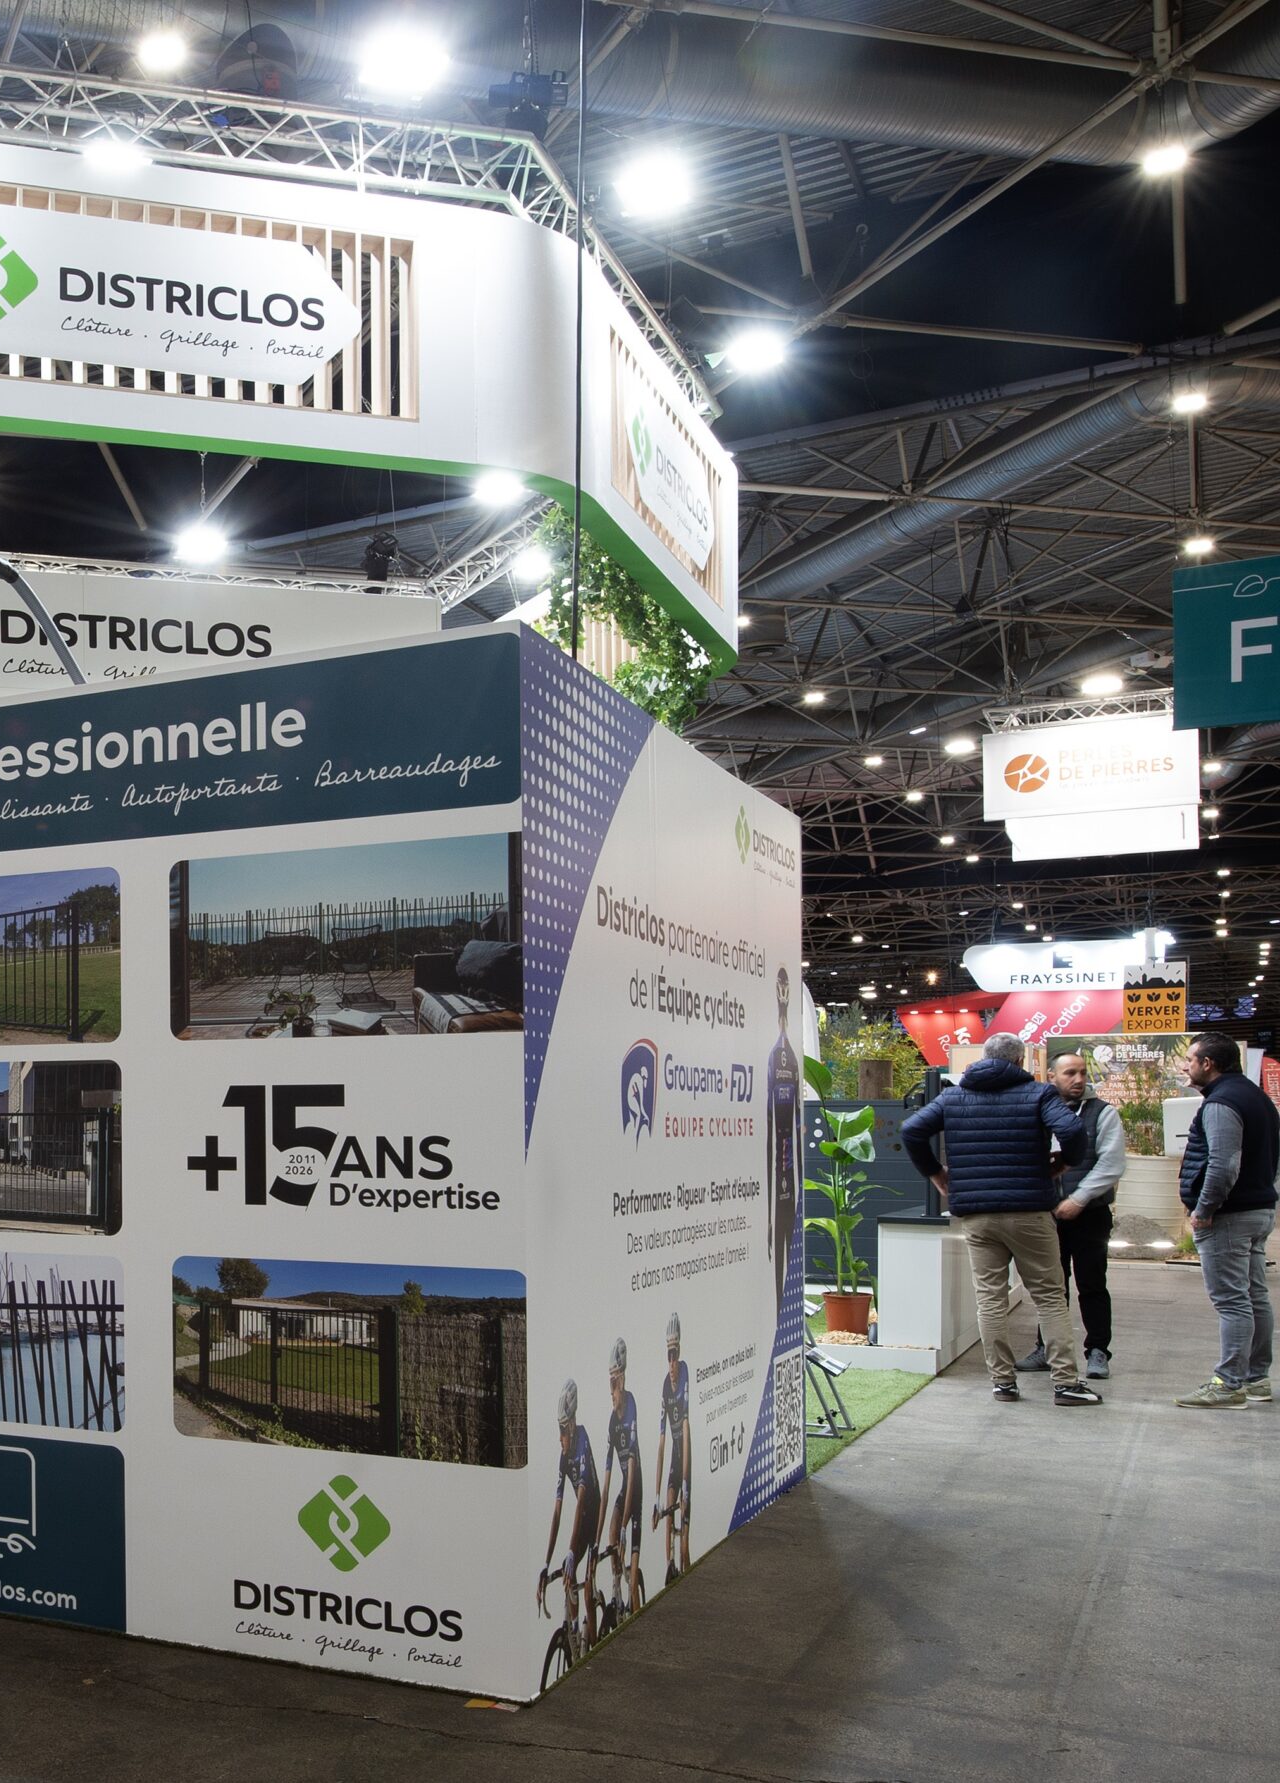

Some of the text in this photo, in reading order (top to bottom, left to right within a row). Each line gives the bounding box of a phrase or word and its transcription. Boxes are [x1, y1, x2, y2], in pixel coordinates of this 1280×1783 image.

[59, 266, 325, 331] DISTRICLOS
[61, 316, 325, 359] Clôture Grillage Portail
[656, 444, 708, 531] DISTRICLOS
[3, 658, 157, 680] Clôtur Grill
[1231, 616, 1278, 683] F
[121, 771, 282, 816] Autoportants
[315, 752, 501, 788] Barreaudages
[1059, 757, 1174, 781] DE PIERRES
[753, 830, 796, 872] DISTRICLOS
[597, 885, 766, 978] Districlos partenaire officiel
[1010, 971, 1116, 985] FRAYSSINET
[629, 969, 647, 1009] de
[704, 990, 745, 1030] cycliste
[1127, 1005, 1180, 1016] VERVER
[1127, 1018, 1180, 1030] EXPORT
[1116, 1044, 1148, 1052] PERLES
[1116, 1051, 1164, 1059] DE PIERRES
[664, 1053, 753, 1103] Groupama FDJ
[665, 1112, 753, 1138] ÉQUIPE CYCLISTE
[285, 1165, 313, 1176] 2026
[289, 1154, 316, 1164] 2011
[330, 1135, 453, 1180] ANS
[329, 1183, 500, 1212] D'expertise
[613, 1176, 760, 1217] Performance Rigueur Esprit d'équipe
[626, 1232, 643, 1255] Des
[644, 1227, 671, 1250] valeurs
[670, 1220, 706, 1248] partagées
[707, 1221, 717, 1237] sur
[718, 1216, 726, 1234] les
[631, 1272, 640, 1292] et
[641, 1266, 661, 1288] dans
[661, 1264, 674, 1284] nos
[675, 1255, 707, 1281] magasins
[708, 1252, 724, 1271] toute
[722, 1358, 729, 1371] on
[233, 1579, 463, 1642] DISTRICLOS
[235, 1621, 463, 1669] Clôture Grillage Portail
